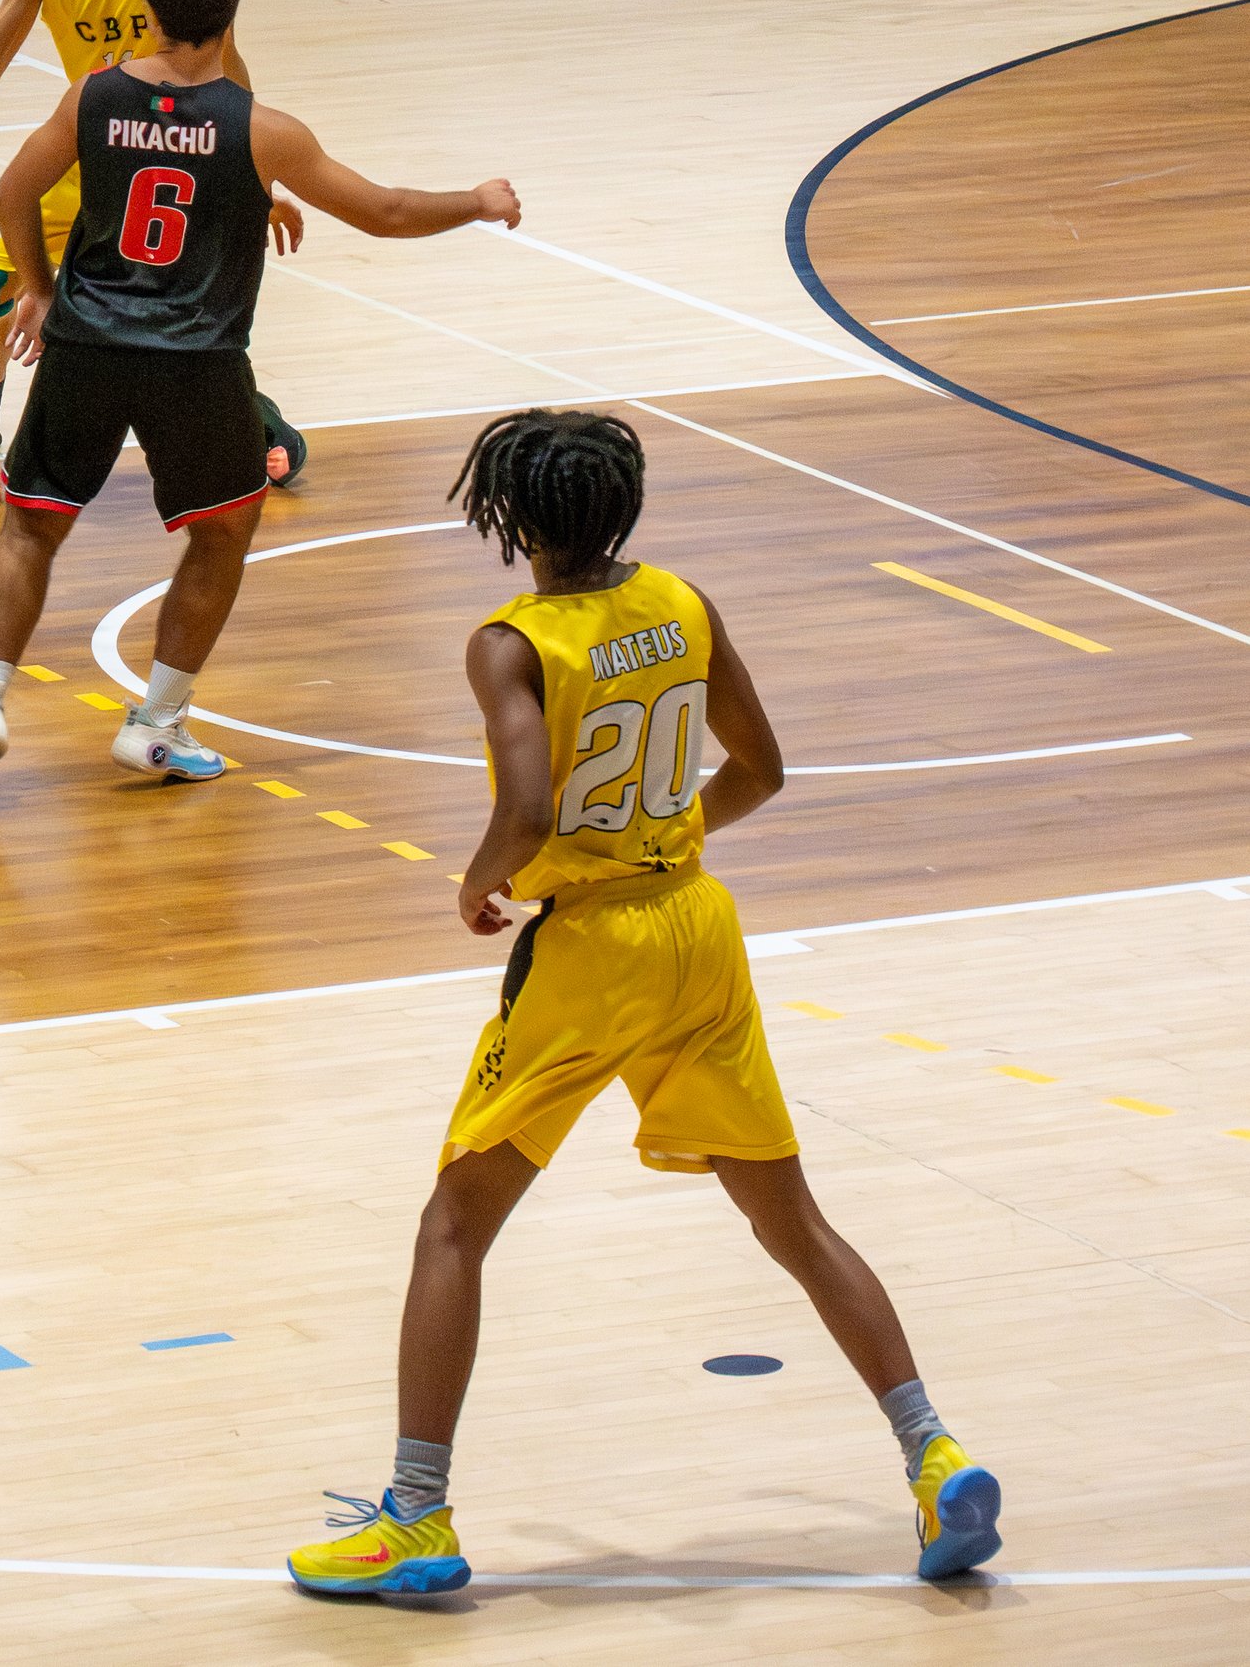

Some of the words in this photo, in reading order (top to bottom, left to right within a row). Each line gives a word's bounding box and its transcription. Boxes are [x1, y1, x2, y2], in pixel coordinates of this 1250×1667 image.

[108, 118, 216, 155] PIKACHÚ
[118, 166, 196, 266] 6
[588, 620, 688, 682] MATEUS
[557, 679, 708, 835] 20
